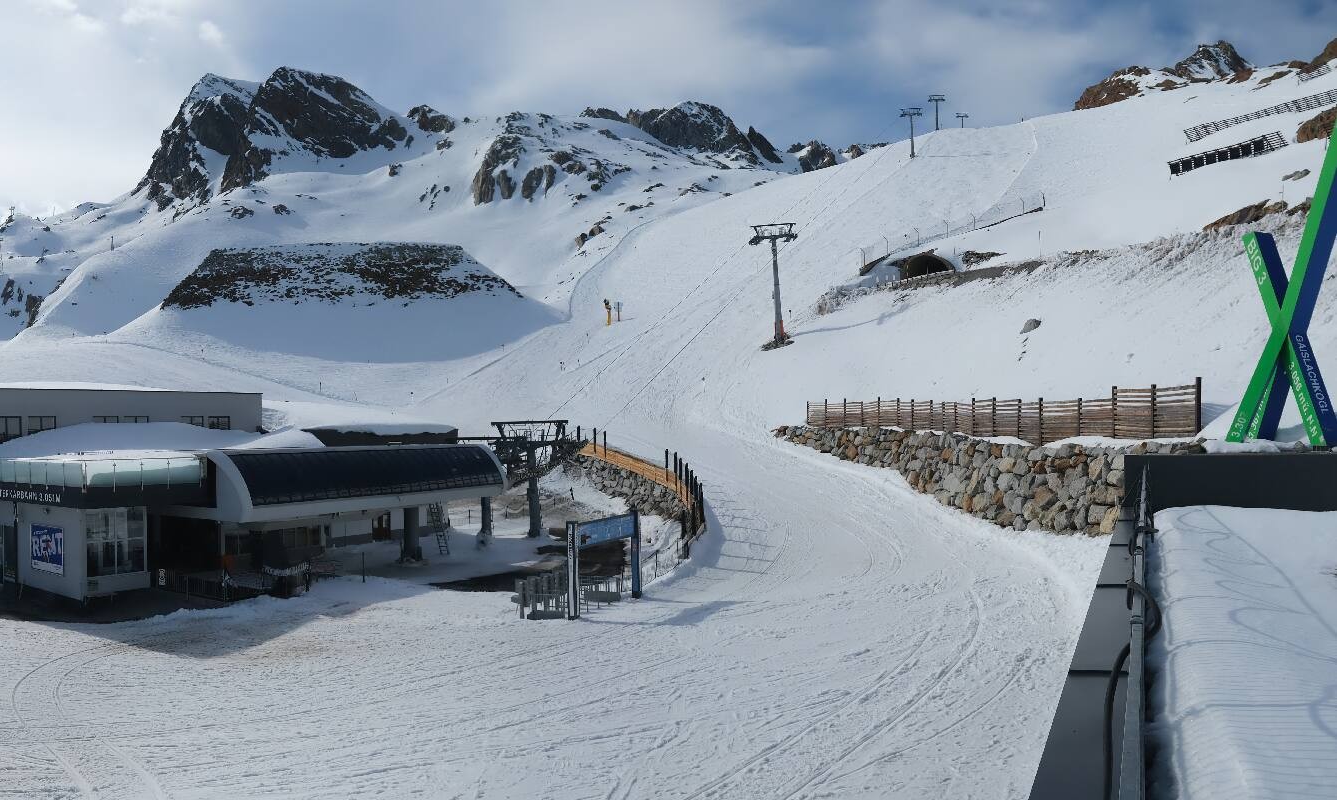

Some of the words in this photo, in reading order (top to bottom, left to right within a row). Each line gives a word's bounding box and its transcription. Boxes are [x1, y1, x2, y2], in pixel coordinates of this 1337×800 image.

[1247, 237, 1262, 271] BIG
[1258, 271, 1267, 285] 3
[1295, 334, 1329, 414] GAISLACHKOGL
